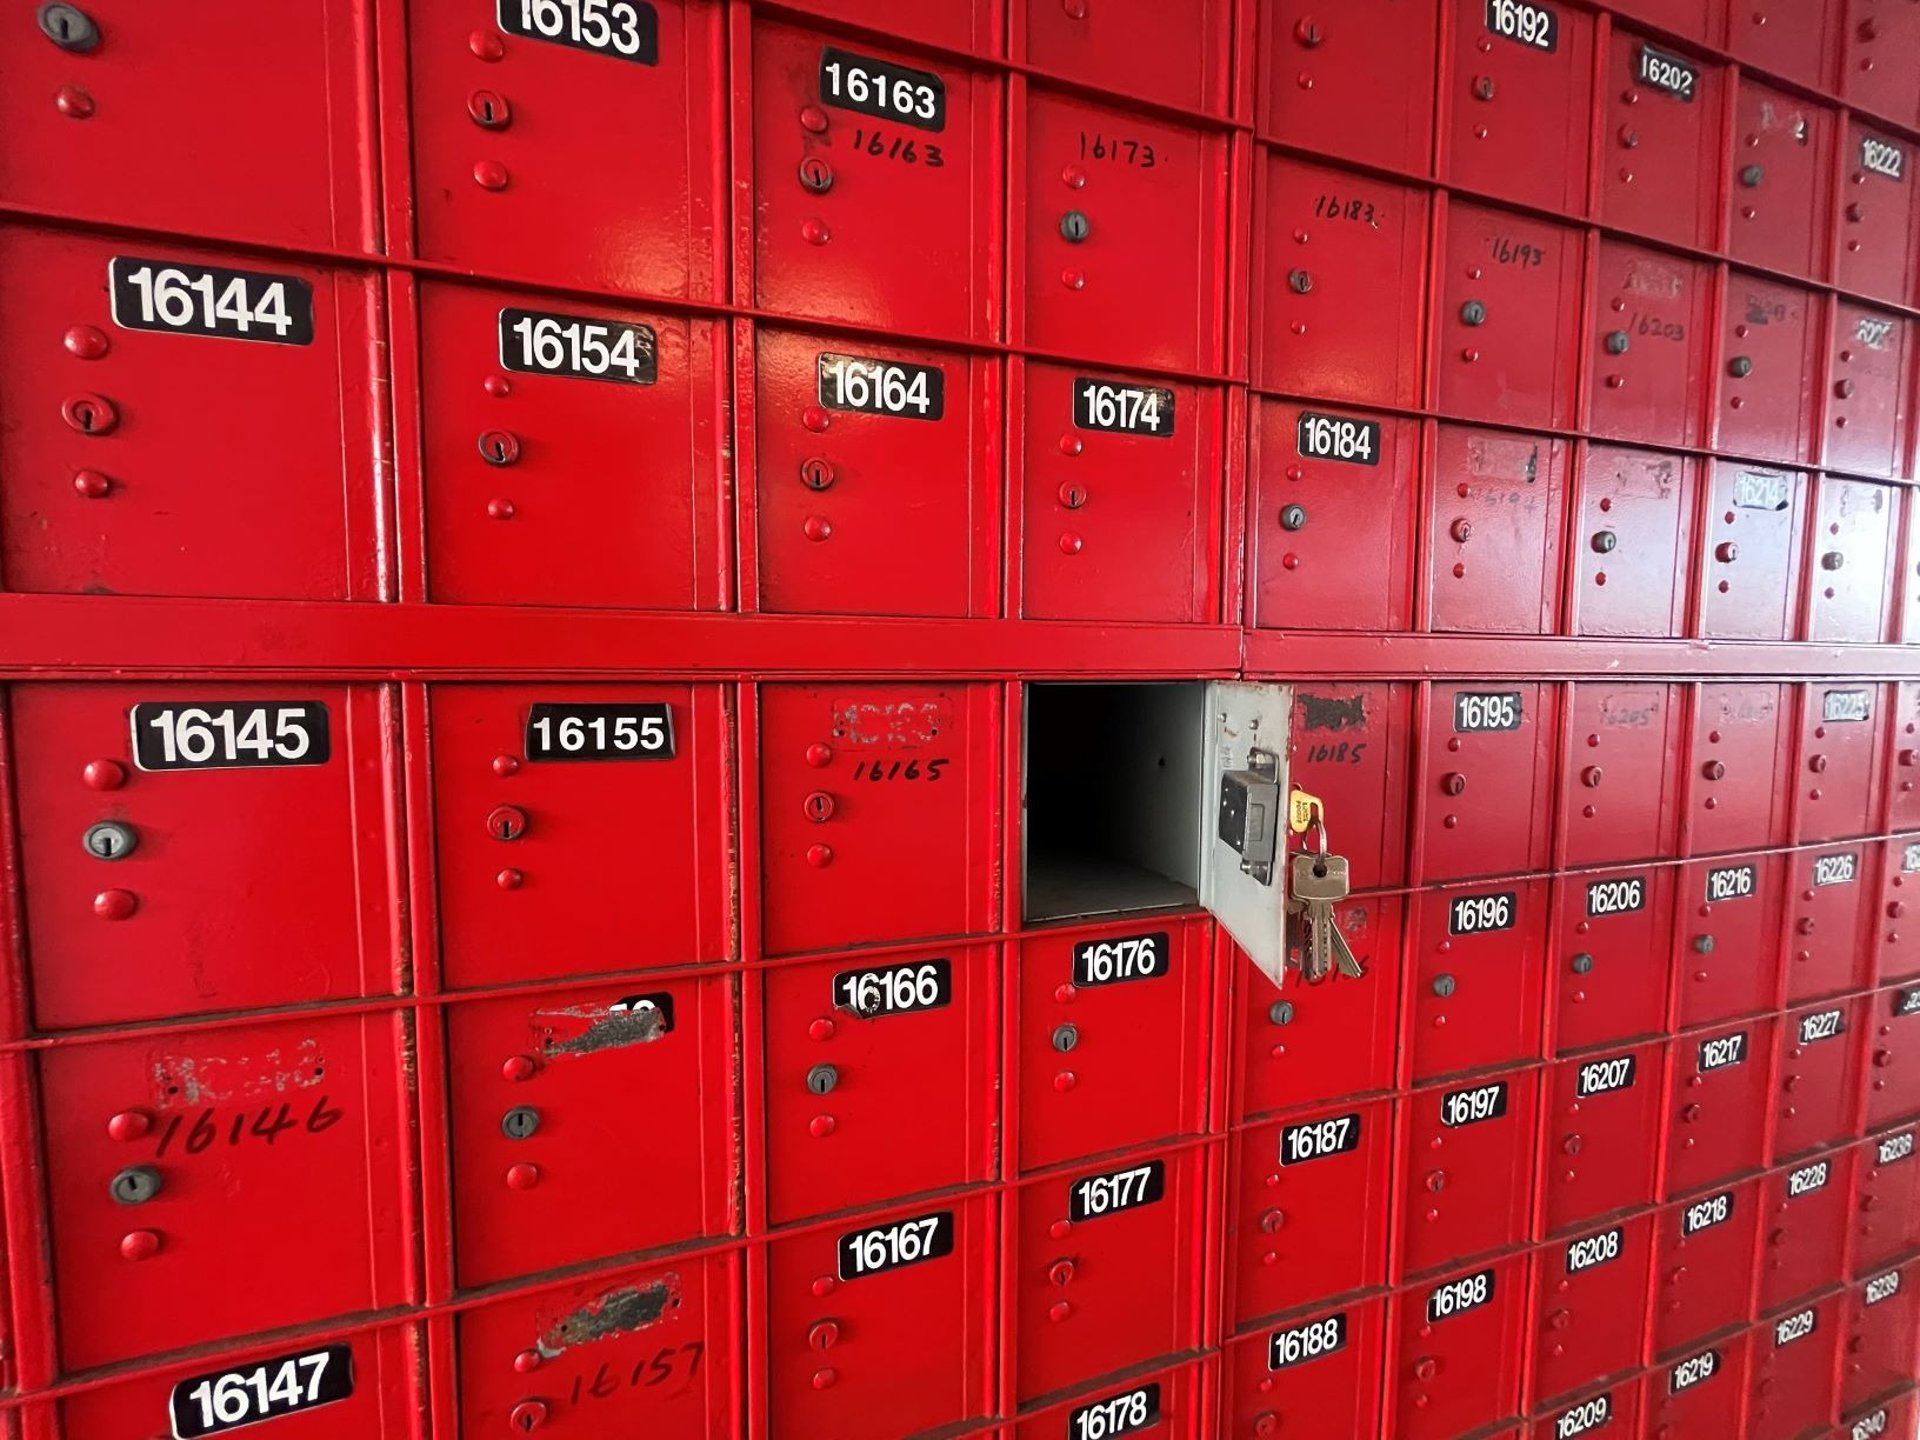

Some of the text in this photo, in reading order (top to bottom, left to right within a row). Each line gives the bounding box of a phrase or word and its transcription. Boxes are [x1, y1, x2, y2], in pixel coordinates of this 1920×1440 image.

[519, 0, 640, 56] 16153
[1493, 0, 1549, 47] 16192
[826, 63, 936, 119] 16163
[1641, 54, 1693, 94] 16202
[854, 130, 944, 168] 16163
[1863, 138, 1900, 177] 16222
[127, 266, 292, 335] 16144
[513, 317, 640, 376] 16154
[1628, 313, 1685, 342] 16203
[829, 360, 930, 414] 16164
[1083, 386, 1161, 431] 16174
[1305, 418, 1371, 460] 16184
[1459, 696, 1514, 728] 16195
[150, 707, 309, 762] 16145
[533, 716, 665, 751] 16155
[1308, 743, 1367, 764] 16185
[854, 758, 949, 782] 16165
[1711, 867, 1752, 898] 16216
[1815, 854, 1853, 883] 16226
[1455, 896, 1509, 931] 16196
[1589, 880, 1641, 913] 16206
[1082, 938, 1155, 982] 16176
[843, 964, 939, 1013] 16166
[1803, 1010, 1841, 1040] 16227
[1703, 1035, 1742, 1068] 16217
[1581, 1058, 1630, 1093] 16207
[1448, 1086, 1500, 1125] 16197
[155, 1095, 342, 1158] 16146
[1287, 1118, 1350, 1160] 16187
[1078, 1166, 1151, 1217] 16177
[1790, 1161, 1827, 1196] 16228
[1688, 1195, 1727, 1232] 16218
[848, 1217, 939, 1273] 16167
[1569, 1231, 1618, 1271] 16208
[1432, 1274, 1487, 1317] 16198
[1275, 1317, 1338, 1365] 16188
[1776, 1309, 1813, 1345] 16229
[188, 1351, 331, 1429] 16147
[570, 1341, 705, 1405] 16157
[1675, 1352, 1714, 1389] 16219
[1076, 1390, 1147, 1440] 16178
[1557, 1397, 1607, 1440] 16209
